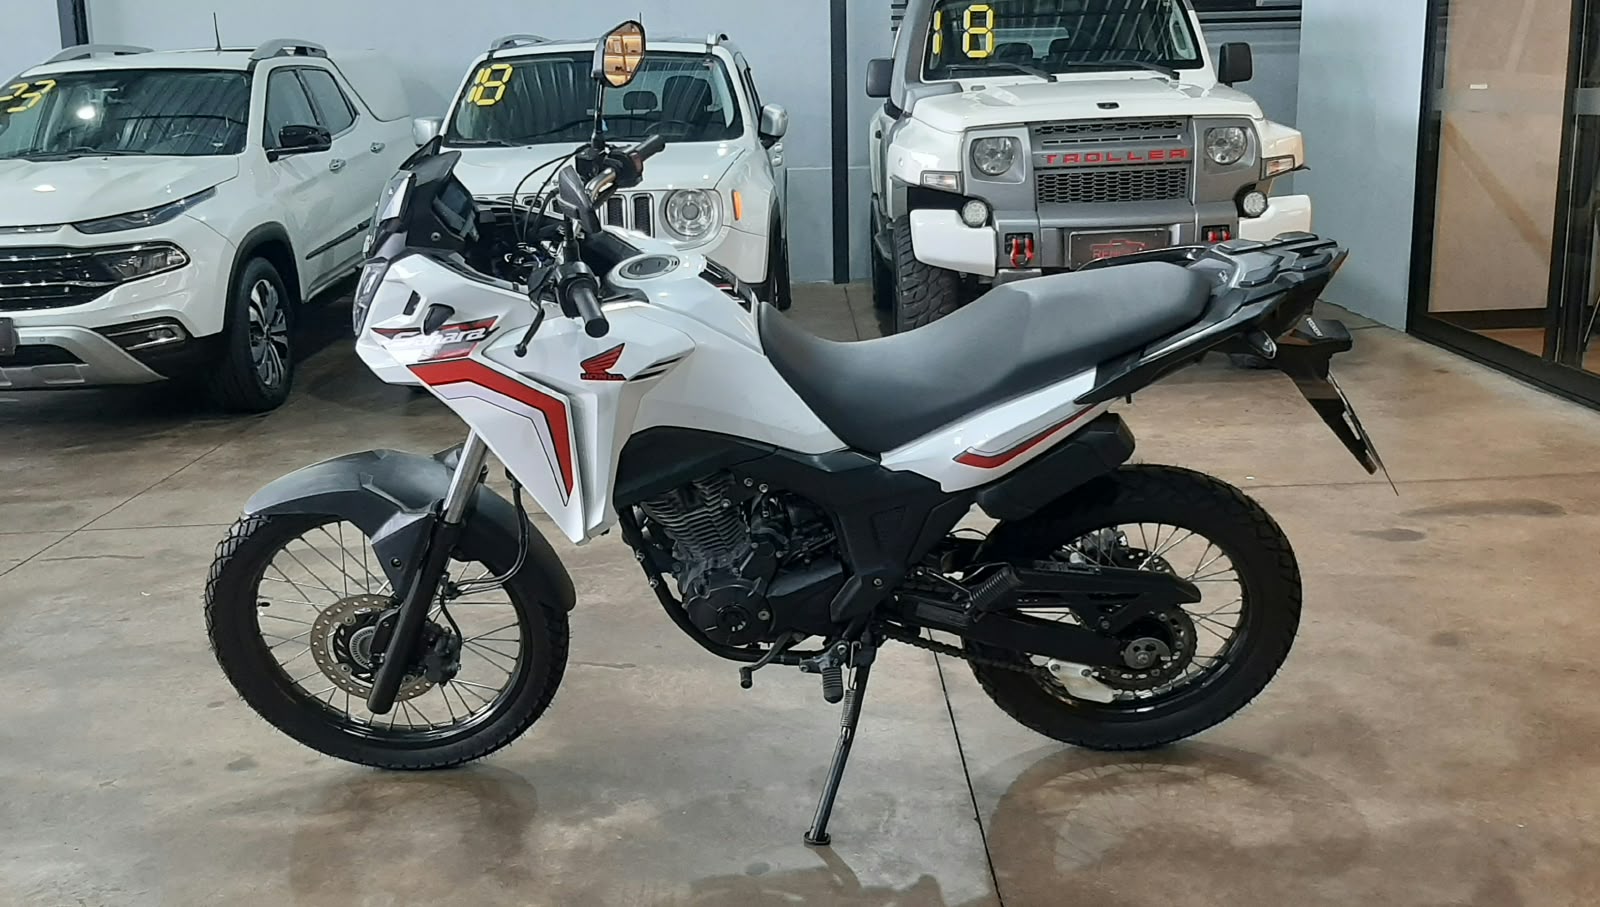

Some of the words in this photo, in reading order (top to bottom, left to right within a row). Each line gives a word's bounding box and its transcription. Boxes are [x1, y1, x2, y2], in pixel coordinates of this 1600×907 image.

[932, 4, 994, 58] 18
[467, 63, 513, 106] 18
[1042, 149, 1188, 165] TROLLER
[581, 373, 626, 381] HONDA
